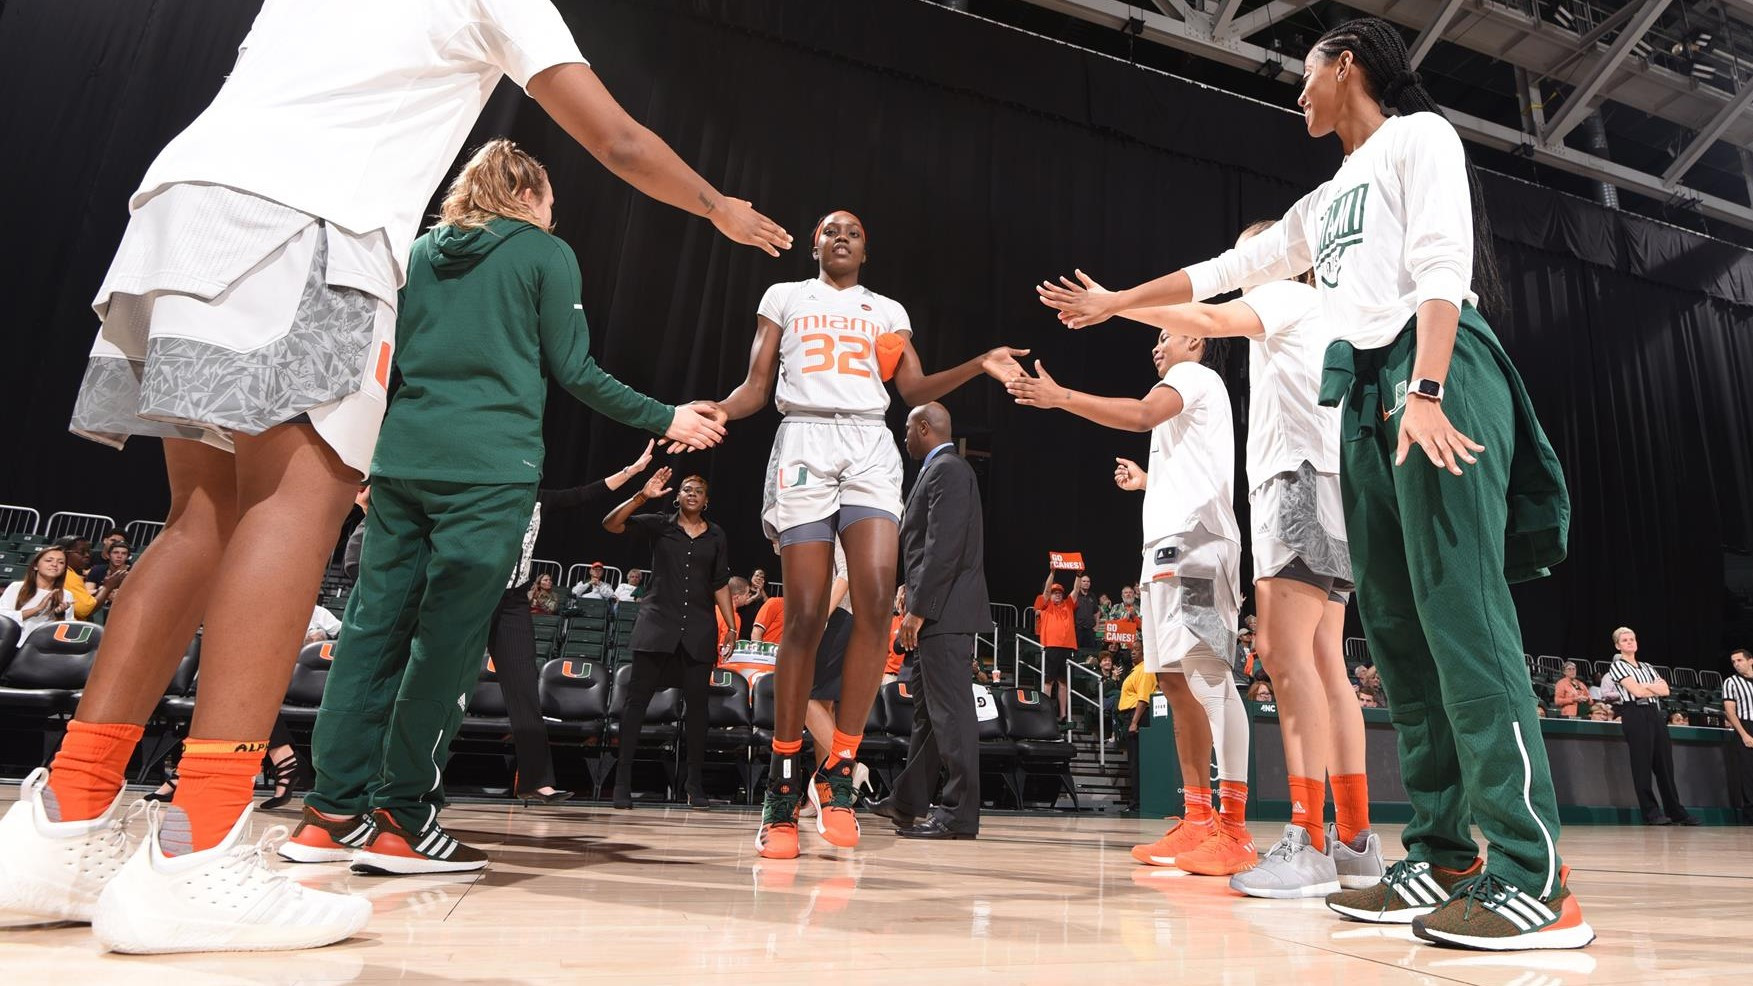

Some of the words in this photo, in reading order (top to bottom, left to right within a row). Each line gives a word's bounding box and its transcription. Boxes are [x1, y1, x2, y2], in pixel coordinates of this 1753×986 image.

[801, 333, 871, 378] 32
[1053, 560, 1083, 569] CANES!
[53, 623, 94, 643] U
[1106, 623, 1117, 632] GO
[1106, 631, 1135, 643] CANES!
[562, 660, 592, 678] U
[1016, 689, 1040, 705] U
